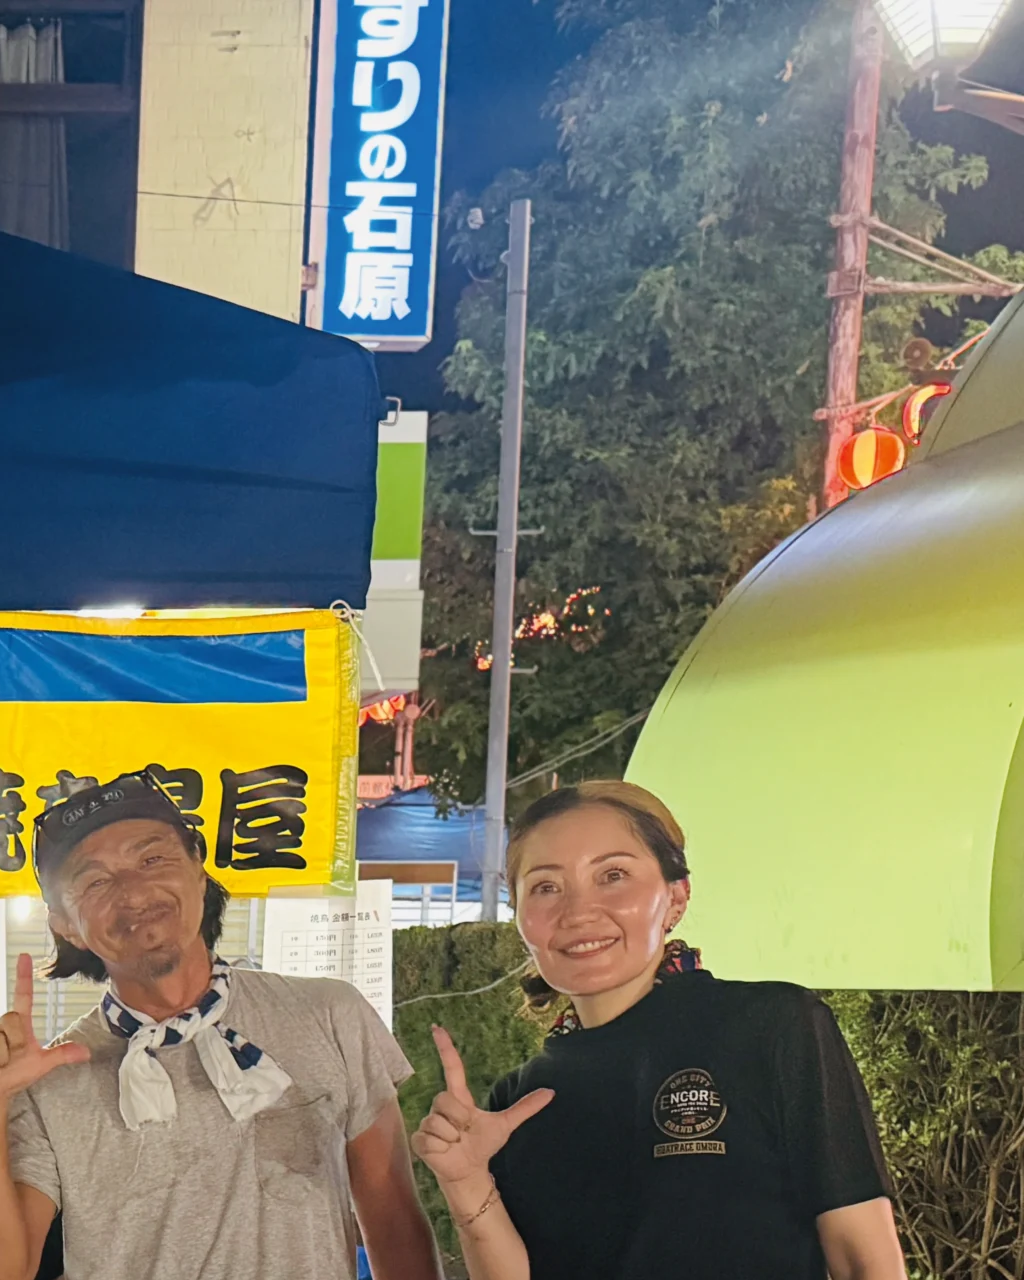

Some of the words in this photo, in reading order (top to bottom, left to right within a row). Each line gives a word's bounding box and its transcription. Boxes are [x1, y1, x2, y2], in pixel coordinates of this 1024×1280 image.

[339, 0, 429, 320] すりの石原
[660, 1090, 721, 1110] ENCORE
[664, 1120, 693, 1133] GRAND
